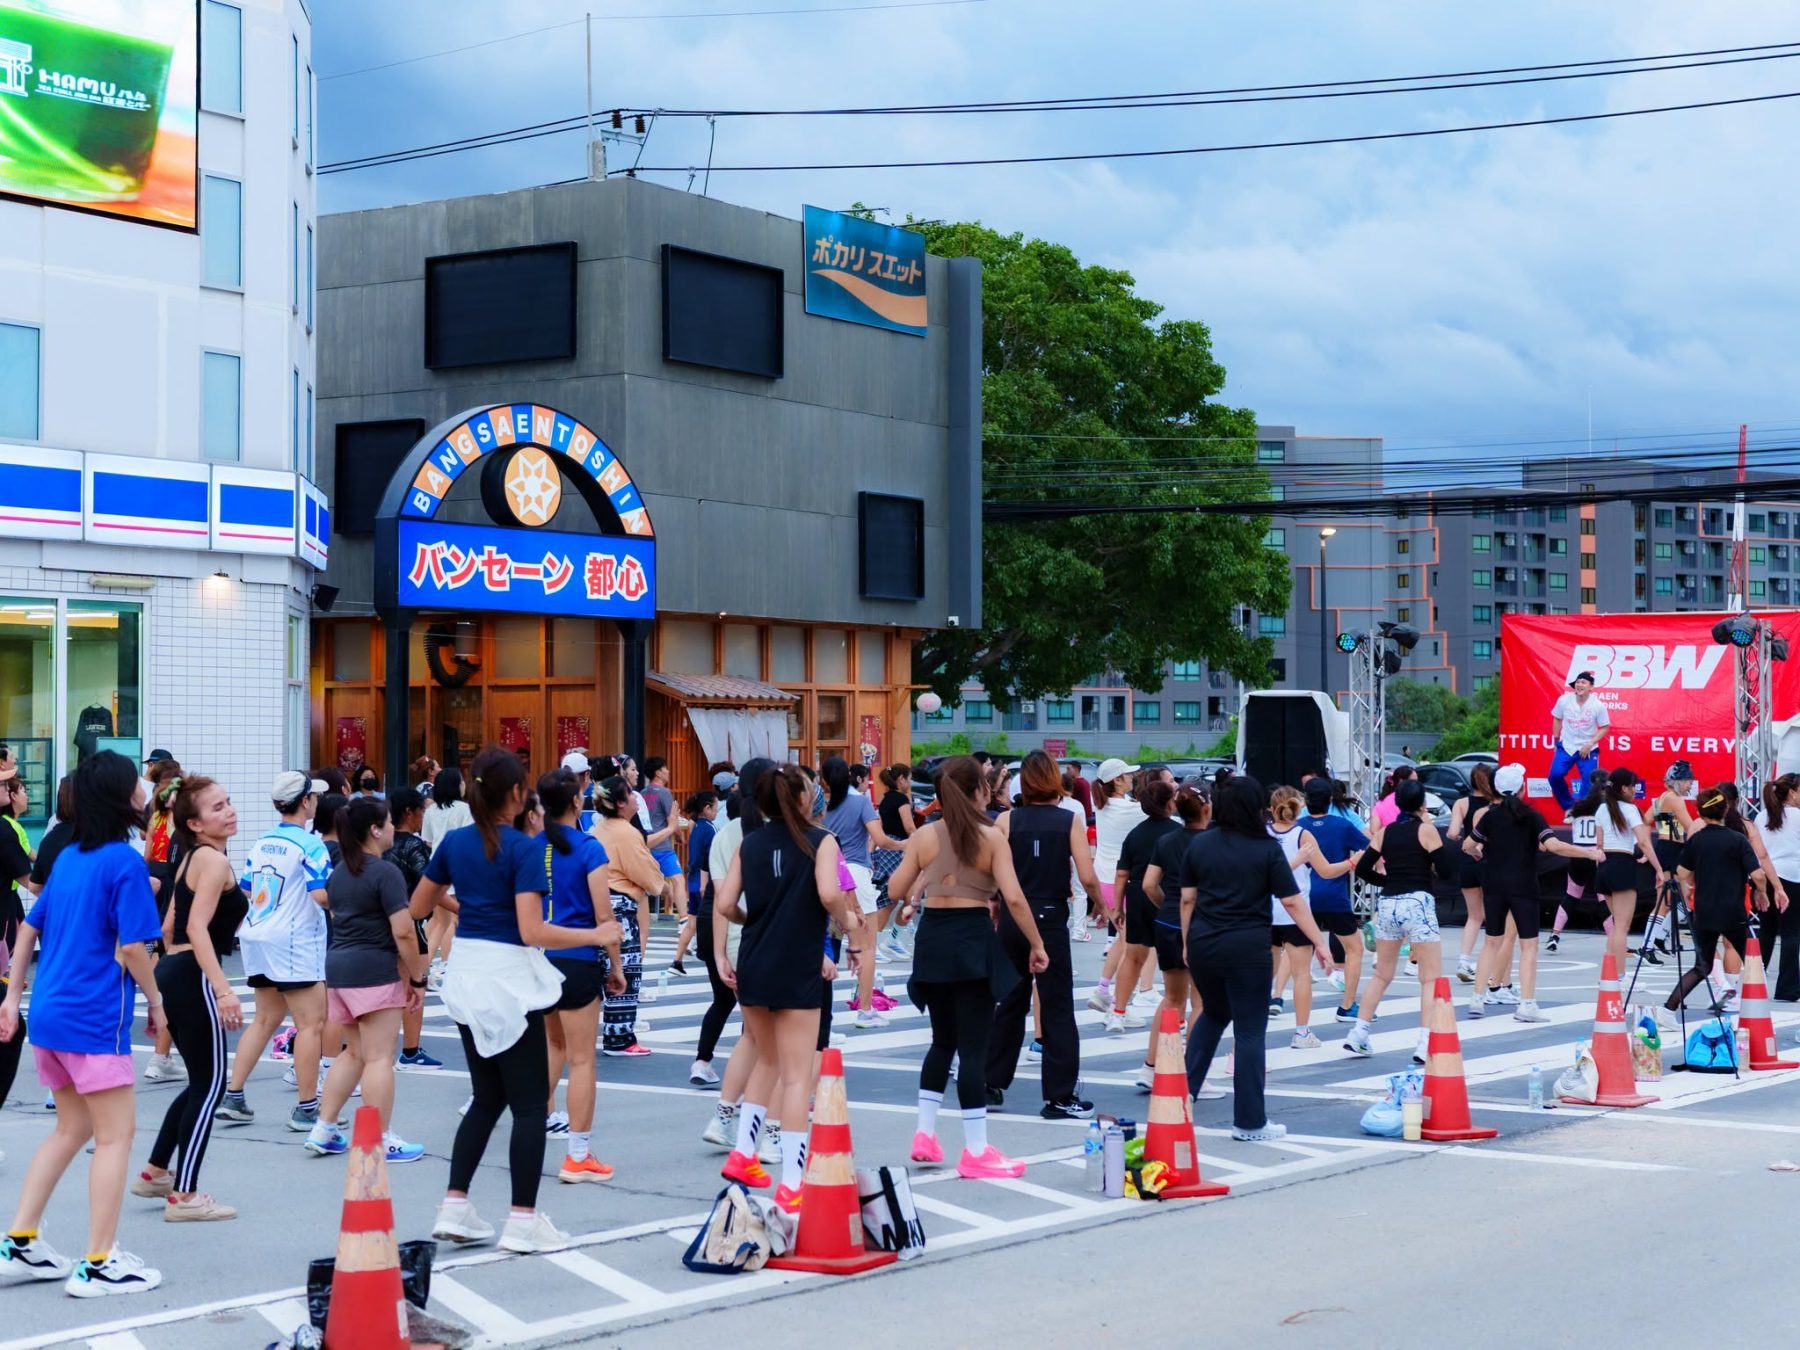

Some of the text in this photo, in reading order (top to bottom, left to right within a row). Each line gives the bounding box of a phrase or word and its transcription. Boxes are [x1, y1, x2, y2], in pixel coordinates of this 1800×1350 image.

[39, 69, 116, 97] HAMU
[812, 234, 922, 284] ポカリ スエット
[408, 540, 648, 601] バンセーン 都心
[1565, 644, 1728, 689] BBW
[1604, 702, 1629, 711] ORKS
[1499, 734, 1555, 749] TTITU
[1609, 736, 1631, 750] IS
[1580, 819, 1597, 838] 10
